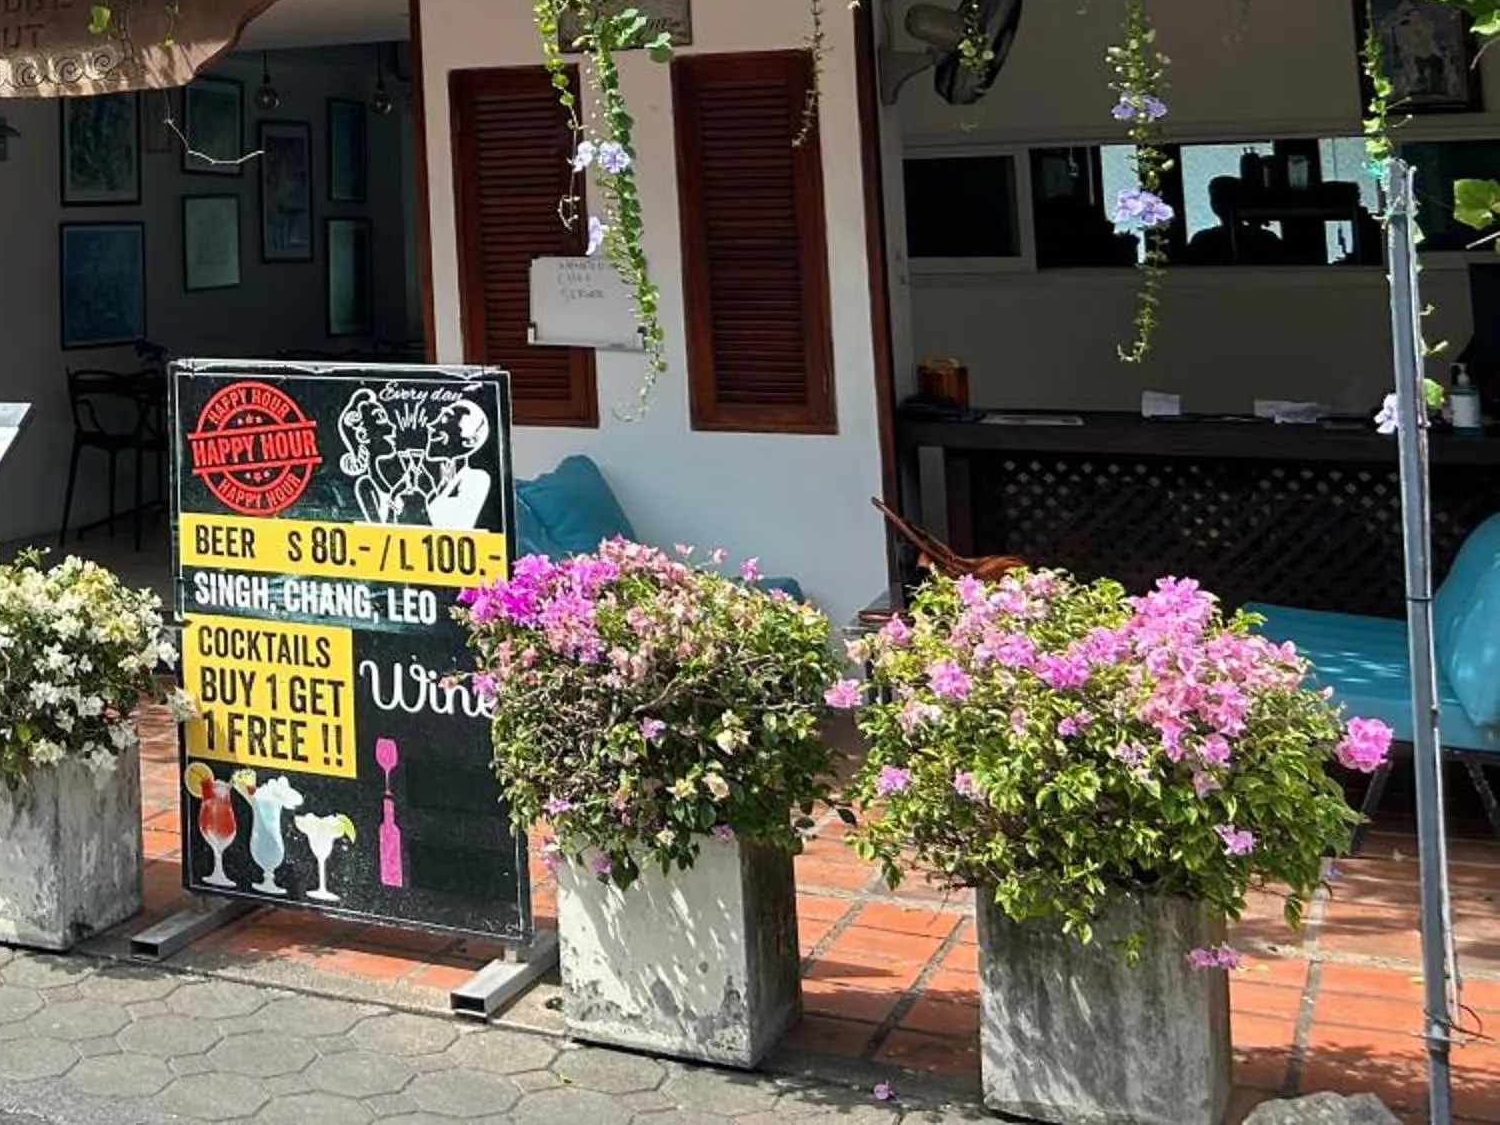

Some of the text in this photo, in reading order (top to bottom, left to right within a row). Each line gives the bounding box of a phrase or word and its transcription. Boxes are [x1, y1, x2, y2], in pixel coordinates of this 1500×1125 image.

[207, 388, 291, 425] HAPPY HOUR
[379, 380, 429, 405] Every
[192, 429, 319, 468] HAPPY HOUR
[217, 472, 302, 508] HAPPY HOUR
[195, 523, 256, 559] BEER
[287, 530, 303, 562] S
[283, 578, 380, 625] CHANG,
[387, 587, 437, 625] LEO
[198, 625, 331, 668] COCKTAILS
[200, 666, 345, 718] BUY 1 GET
[203, 712, 215, 752] 1
[227, 712, 309, 763] FREE
